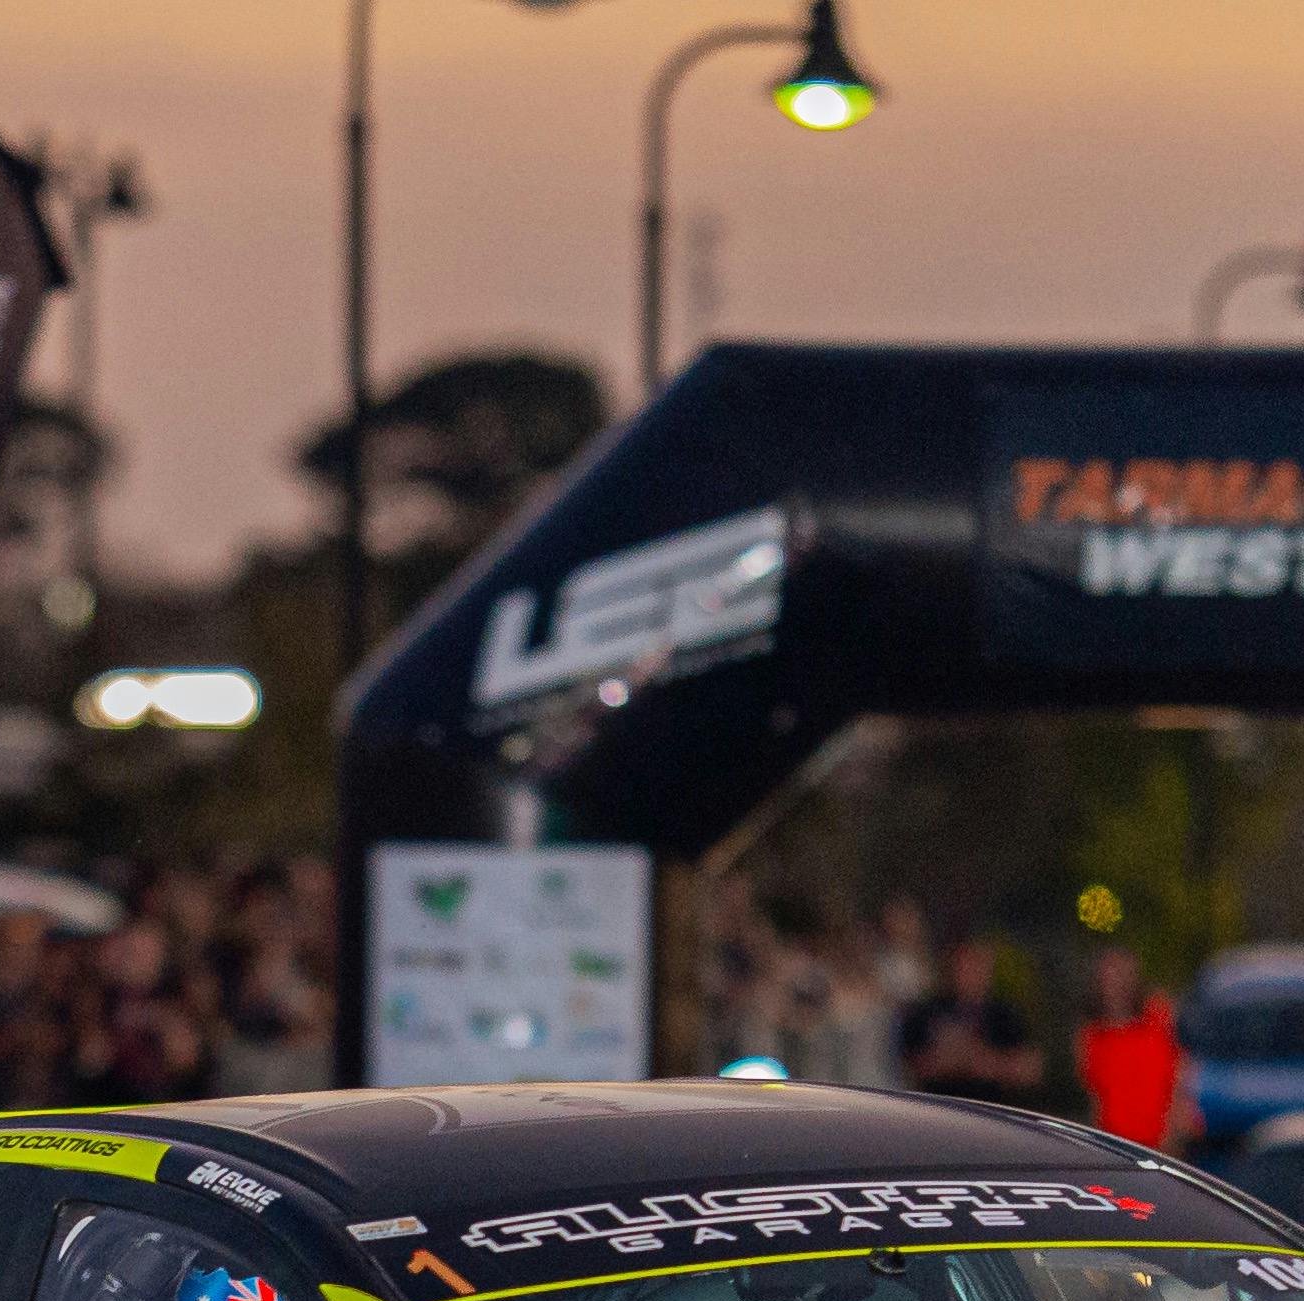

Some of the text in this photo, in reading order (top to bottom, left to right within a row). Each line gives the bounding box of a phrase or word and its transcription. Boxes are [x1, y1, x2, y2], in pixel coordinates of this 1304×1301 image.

[21, 1136, 125, 1156] COATINGS
[217, 1171, 282, 1206] EVOLVE
[609, 1211, 1026, 1253] GARAGE
